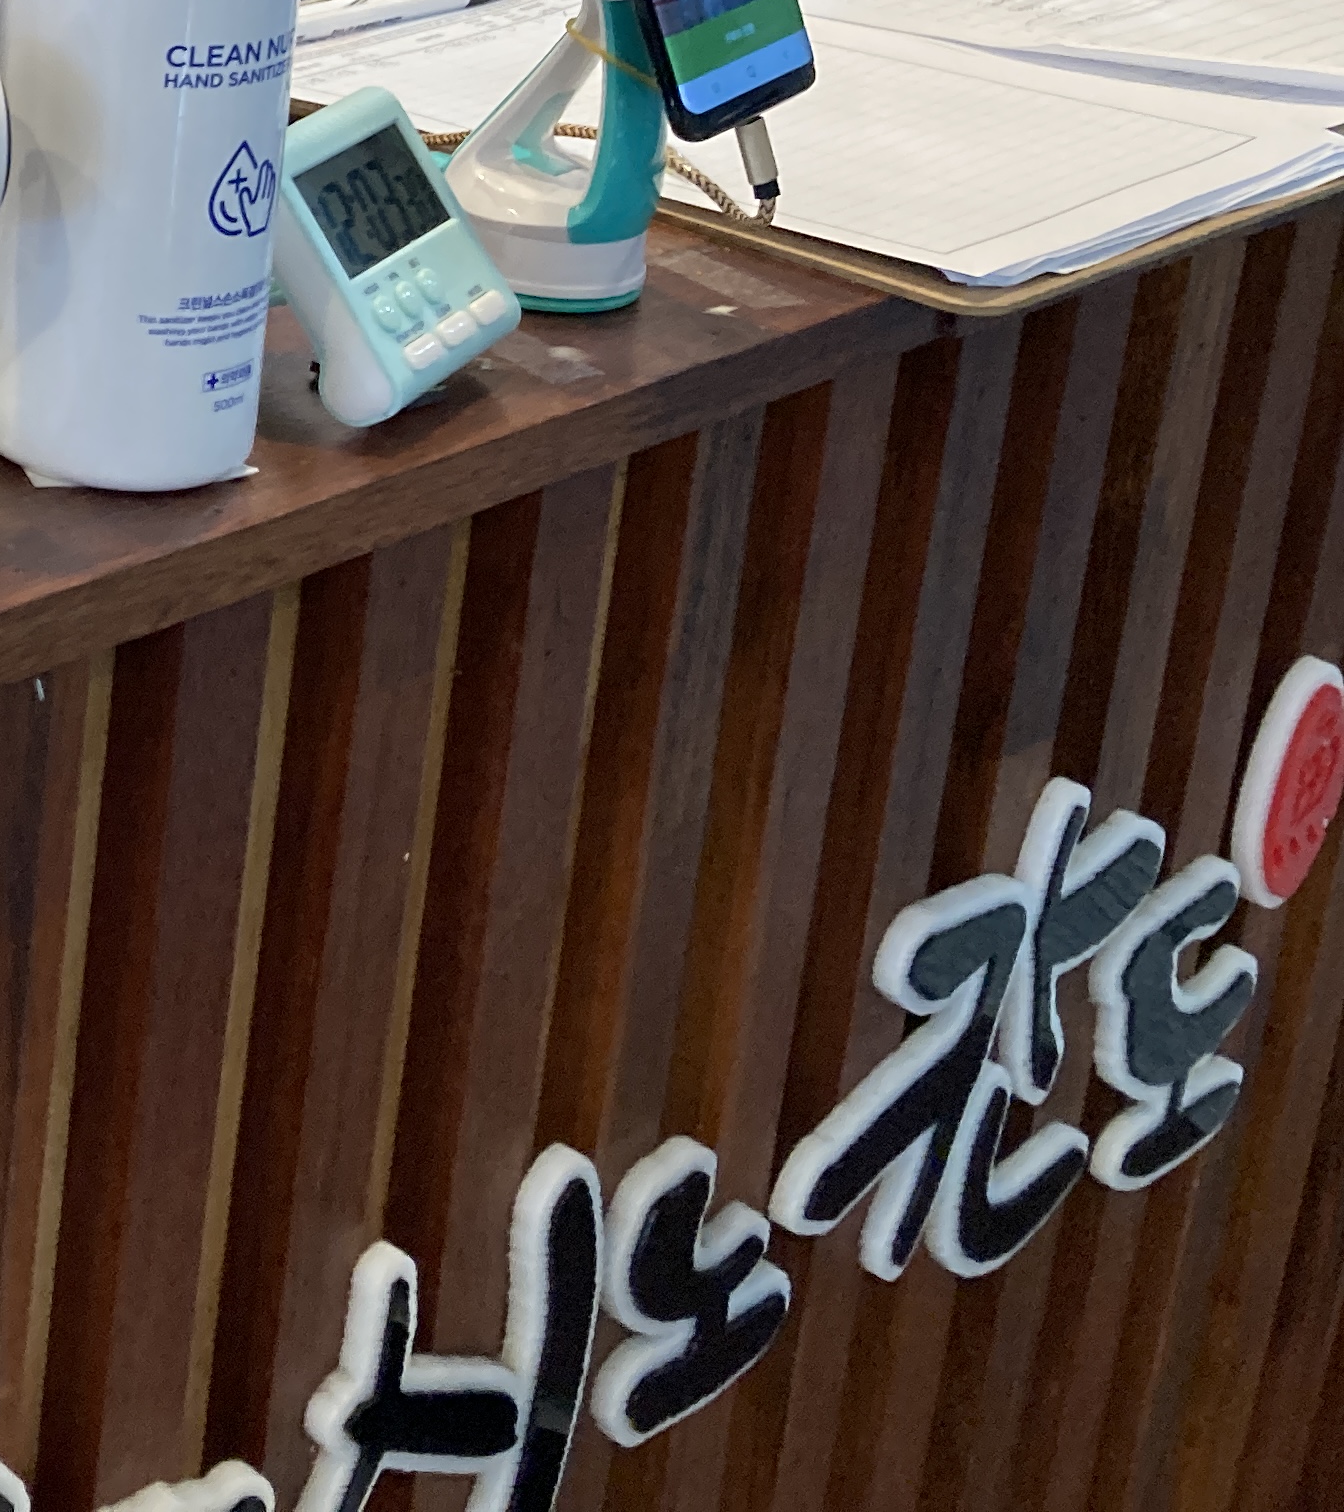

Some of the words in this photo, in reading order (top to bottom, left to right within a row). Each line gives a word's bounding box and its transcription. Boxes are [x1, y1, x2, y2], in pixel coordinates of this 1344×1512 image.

[166, 40, 262, 67] CLEAN
[164, 73, 223, 89] HAND
[228, 57, 290, 87] SANITIZE
